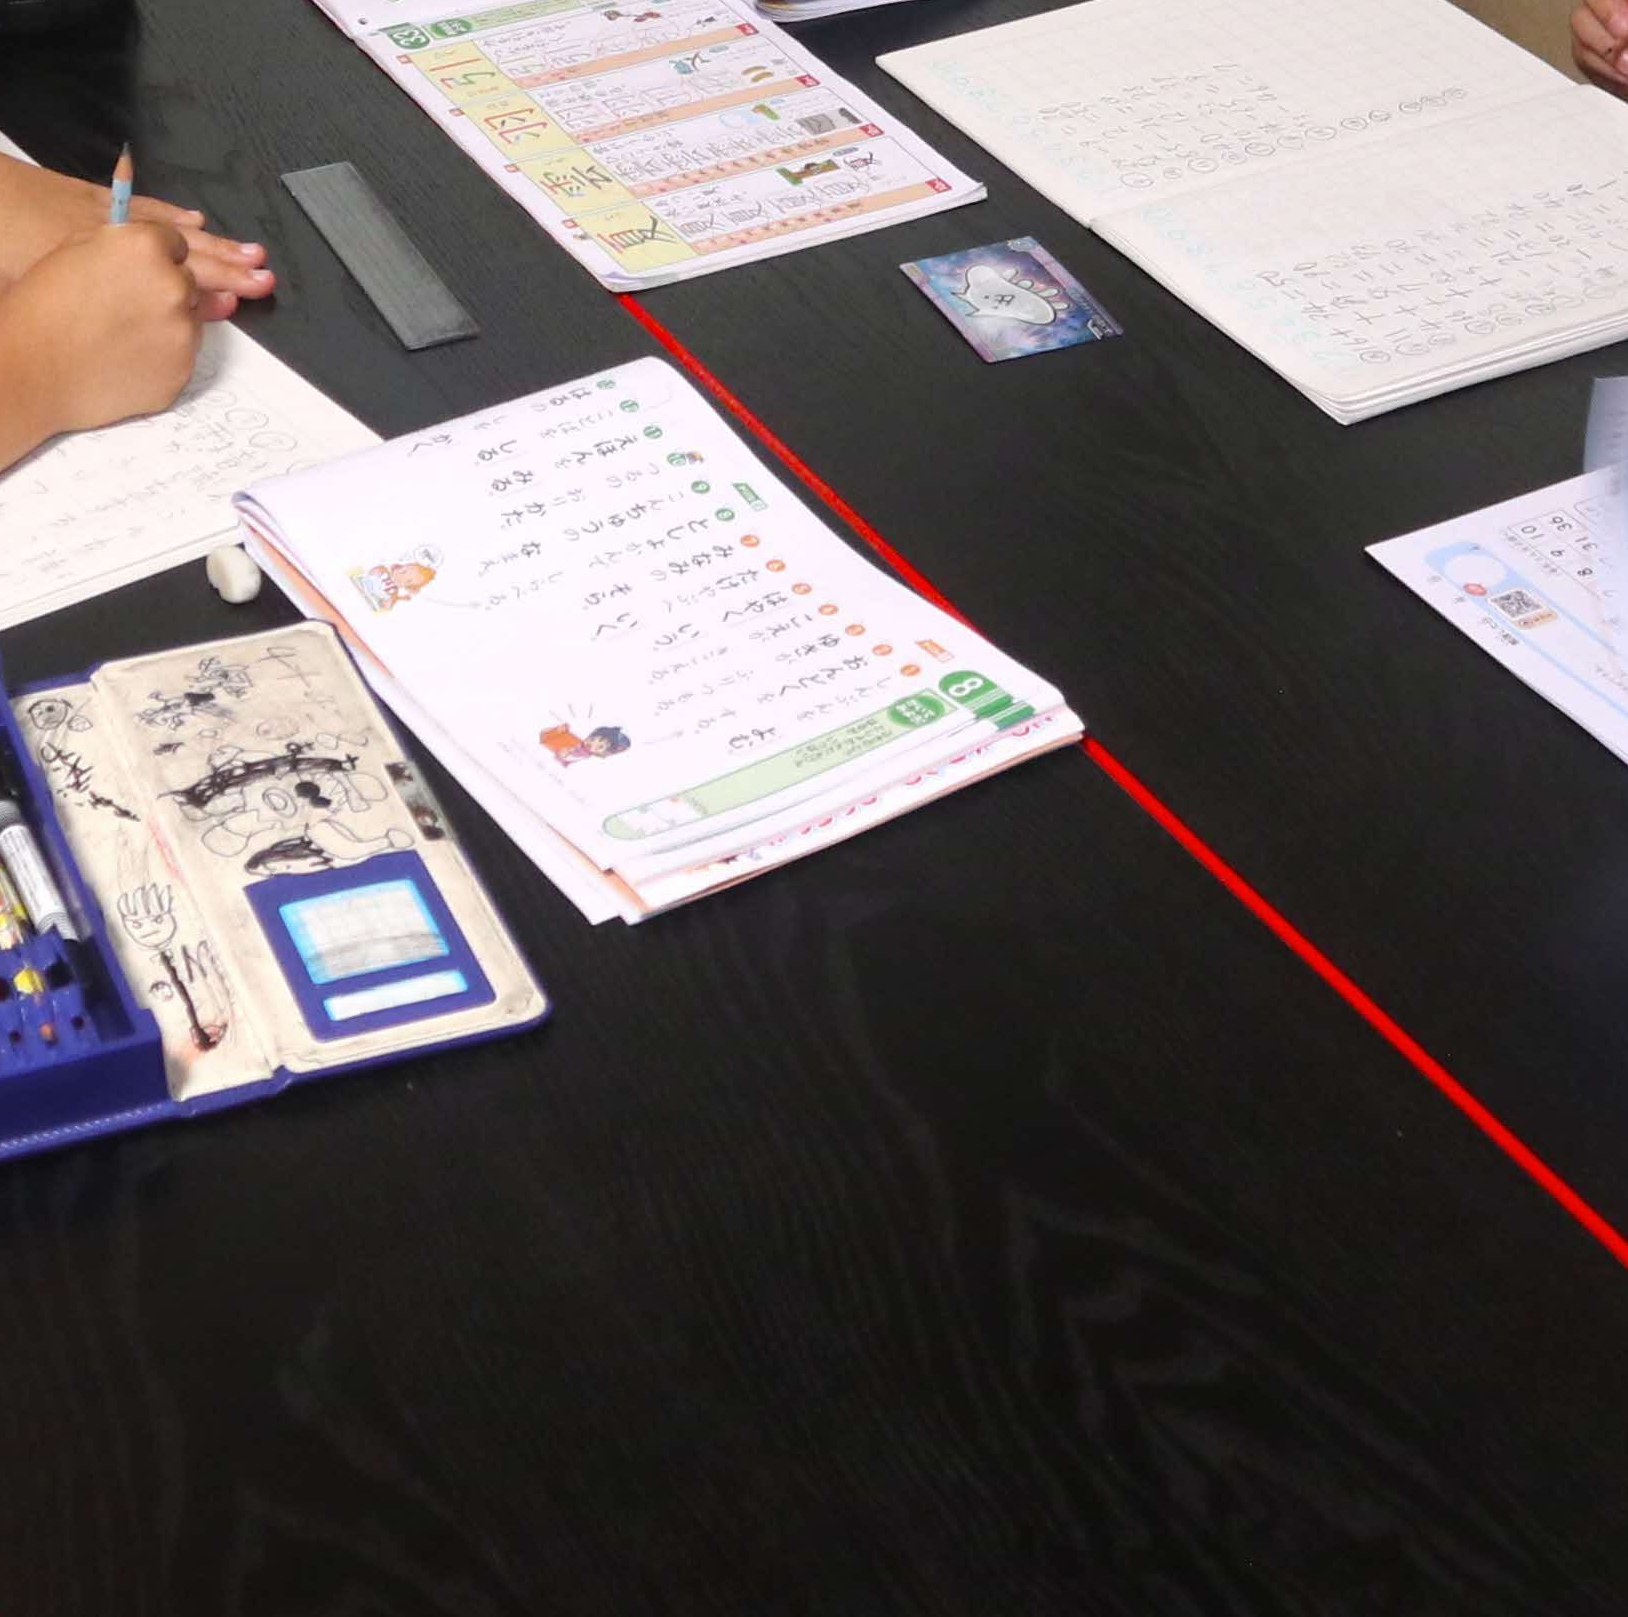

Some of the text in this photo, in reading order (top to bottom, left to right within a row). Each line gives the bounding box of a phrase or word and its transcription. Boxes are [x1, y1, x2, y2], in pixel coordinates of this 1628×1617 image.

[390, 29, 431, 47] 33
[481, 106, 559, 144] 羽
[530, 160, 619, 202] 雲
[589, 213, 681, 258] 夏
[643, 541, 741, 583] みなみの
[713, 589, 793, 624] はやく
[948, 675, 986, 698] 8
